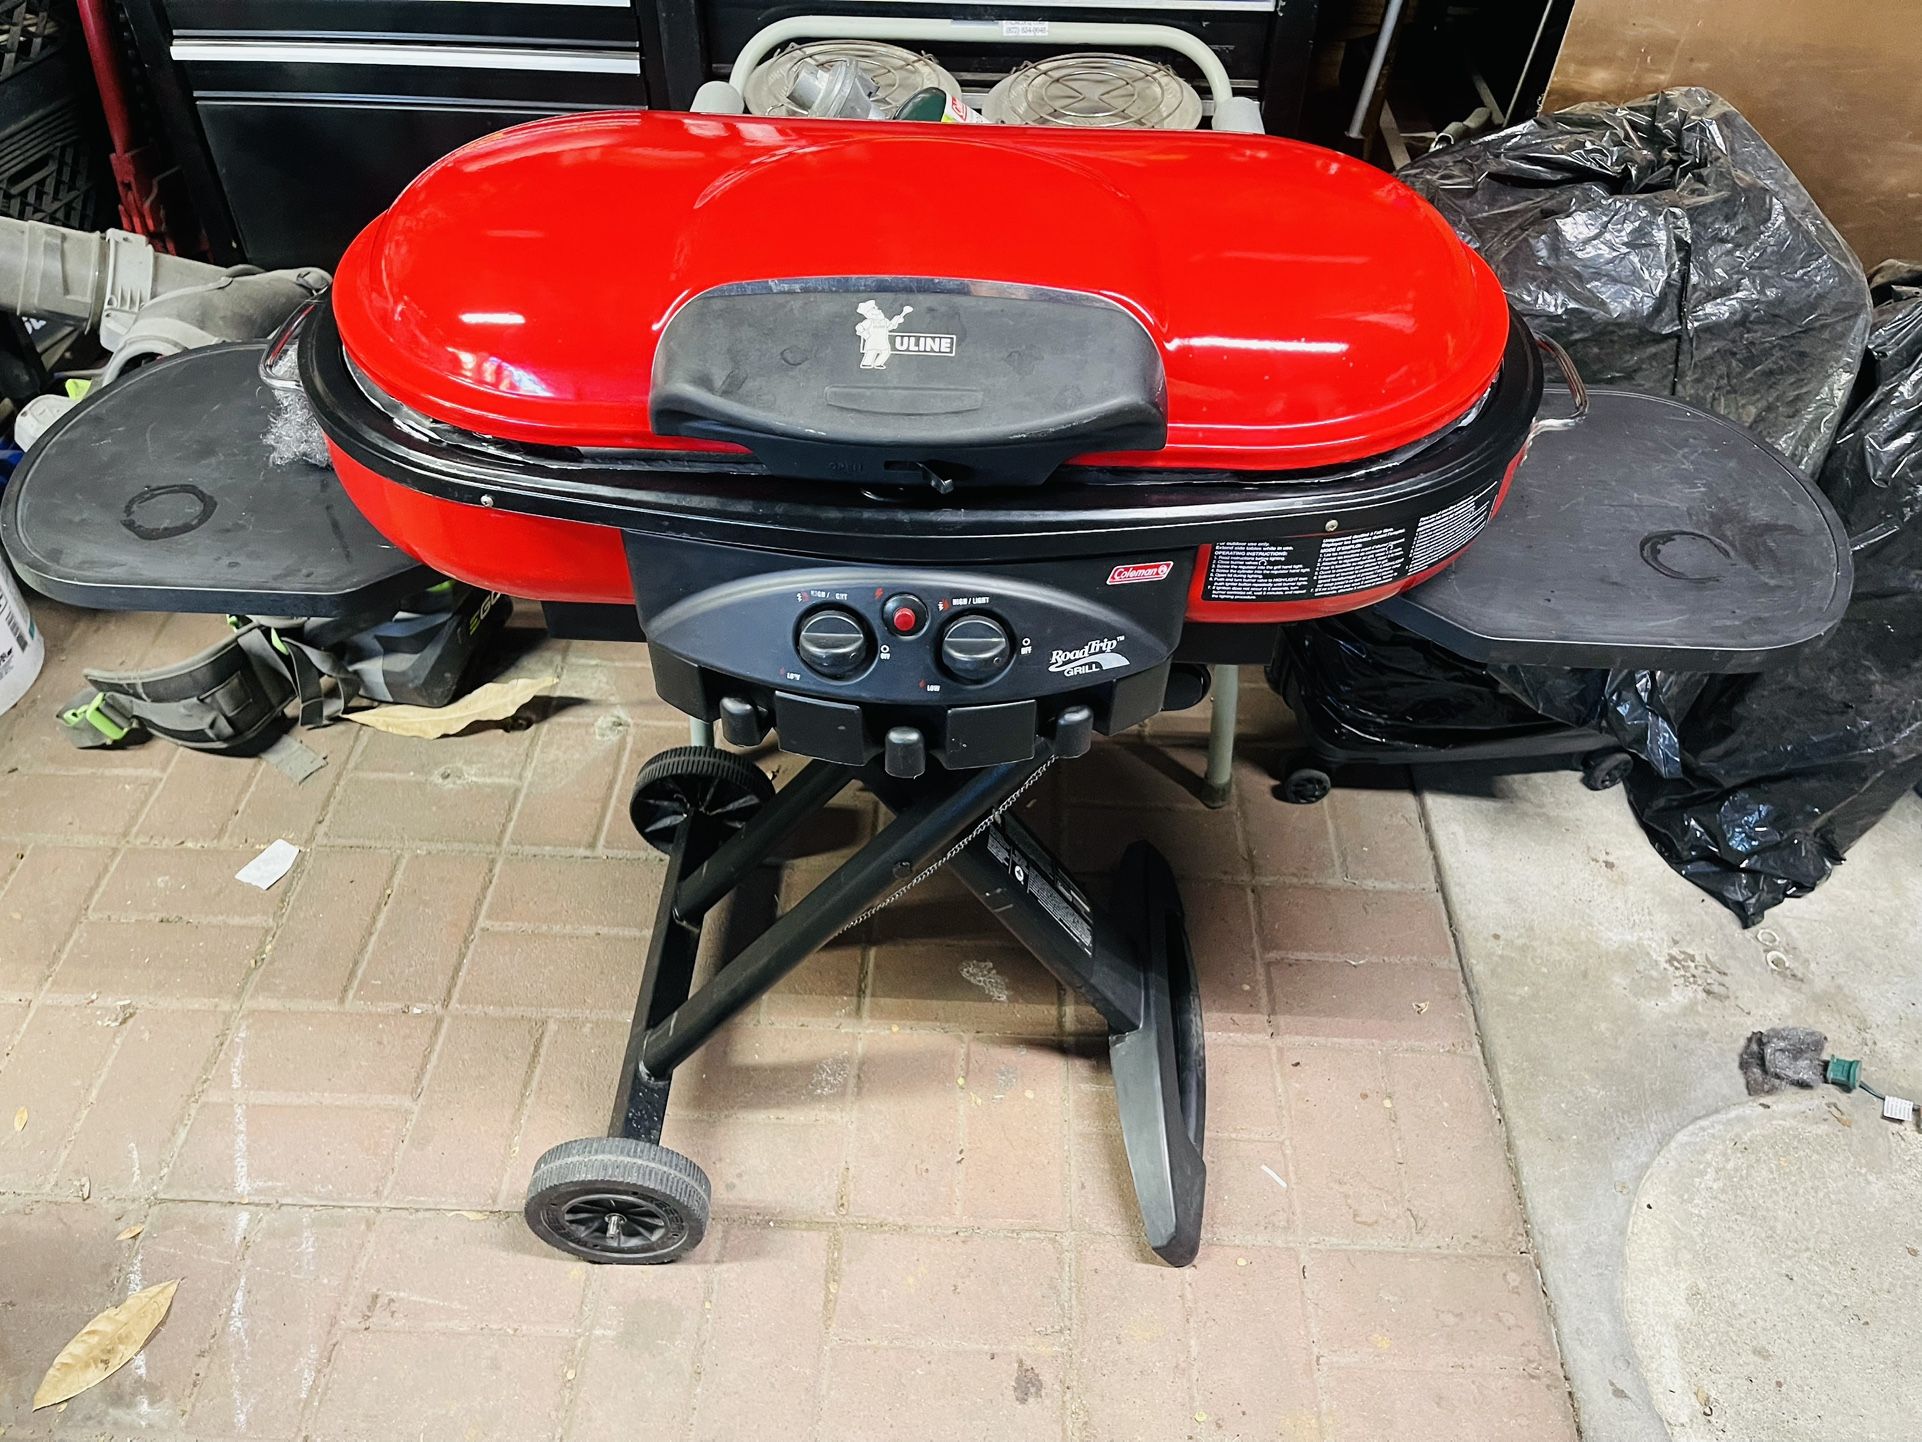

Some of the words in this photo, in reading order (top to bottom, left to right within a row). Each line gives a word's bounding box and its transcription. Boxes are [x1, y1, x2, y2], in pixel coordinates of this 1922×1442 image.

[895, 336, 951, 352] ULINE
[1114, 567, 1156, 580] Coleman
[1064, 663, 1100, 677] GRILL
